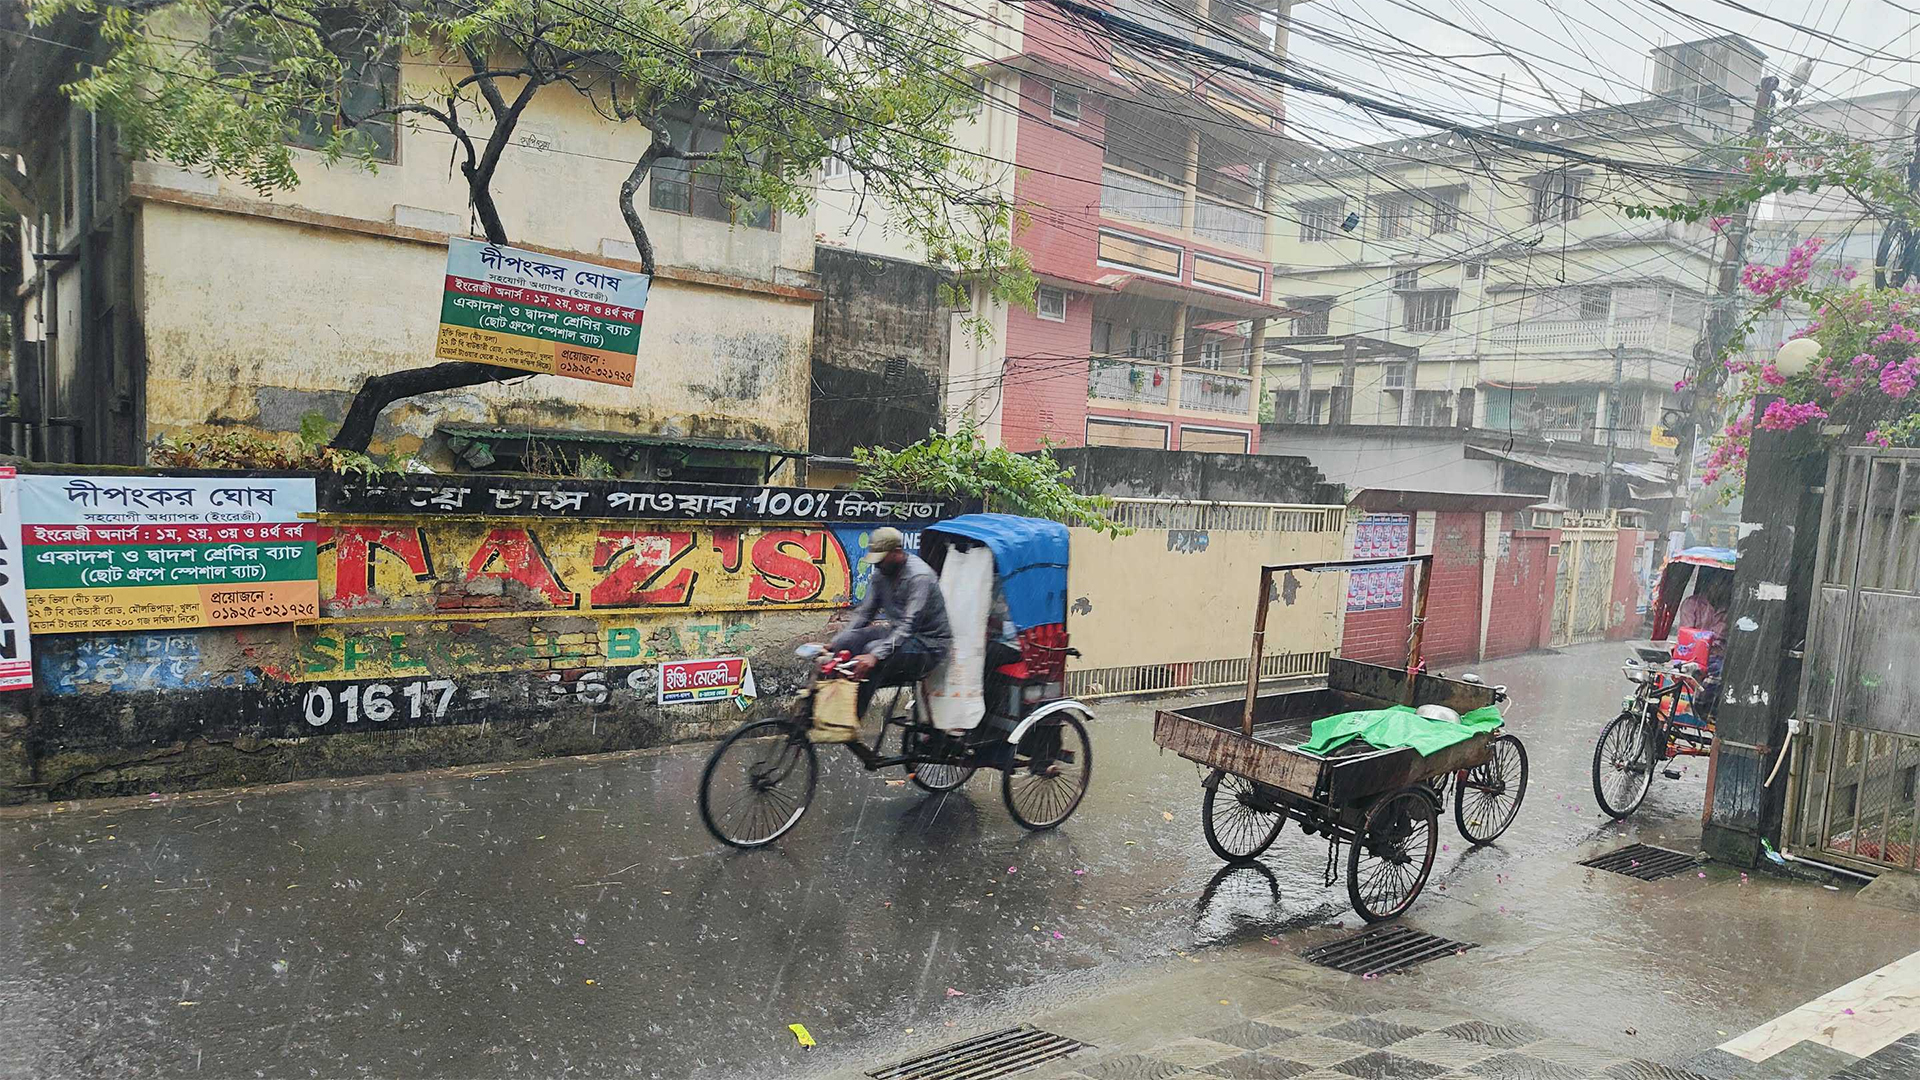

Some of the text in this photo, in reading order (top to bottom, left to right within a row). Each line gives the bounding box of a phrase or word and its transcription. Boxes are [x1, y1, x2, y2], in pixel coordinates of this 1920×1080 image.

[480, 247, 622, 292] দীপংকর ঘোষ
[489, 273, 608, 303] সহযোগী অধ্যাপক (ইংরেজী)
[455, 278, 492, 295] ইংরেজী
[494, 288, 524, 300] অনার্স
[534, 294, 550, 307] ১ম,
[555, 298, 572, 311] ২য়,
[575, 302, 591, 312] ৩য়
[594, 305, 602, 314] ও
[604, 306, 620, 318] ৪র্থ
[621, 309, 636, 320] বর্ষ
[453, 297, 633, 336] একাদশ ও দ্বাদশ শ্রেণির ব্যাচ
[479, 313, 604, 348] (ছোট গ্রুপে স্পেশাল ব্যাচ)
[561, 349, 600, 365] প্রয়োজনে
[560, 362, 632, 382] ০১৯২৫-৩২১৭২৫
[64, 479, 276, 509] দীপংকর ঘোষ
[606, 491, 742, 517] পাওয়ার
[753, 488, 830, 519] 100%
[83, 511, 262, 523] সহযোগী অধ্যাপক (ইংরেজী)
[33, 525, 92, 542] ইংরেজী
[95, 525, 140, 541] অনার্স
[156, 528, 182, 543] ১ম,
[187, 528, 213, 542] ২য়,
[217, 528, 239, 539] ৩য়
[244, 528, 254, 538] ও
[260, 523, 281, 538] ৪র্থ
[284, 523, 304, 538] বর্ষ
[36, 544, 303, 565] একাদশ ও দ্বাদশ শ্রেণির ব্যাচ
[80, 563, 267, 586] (ছোট গ্রুপে স্পেশাল ব্যাচ)
[72, 592, 89, 607] (নীচ
[92, 594, 114, 605] তলা)
[210, 590, 265, 604] প্রয়োজনে
[28, 609, 42, 619] ১২
[43, 606, 53, 617] টি
[55, 606, 64, 616] বি
[179, 603, 200, 613] খুলনা
[58, 619, 88, 628] টাওয়ার
[92, 619, 113, 627] থেকে
[115, 619, 134, 627] ২০০
[137, 617, 150, 625] গজ
[178, 613, 200, 624] দিকে)
[212, 603, 315, 619] ০১৯২৫-৩২১৭২৫
[694, 663, 729, 686] মেহেদী
